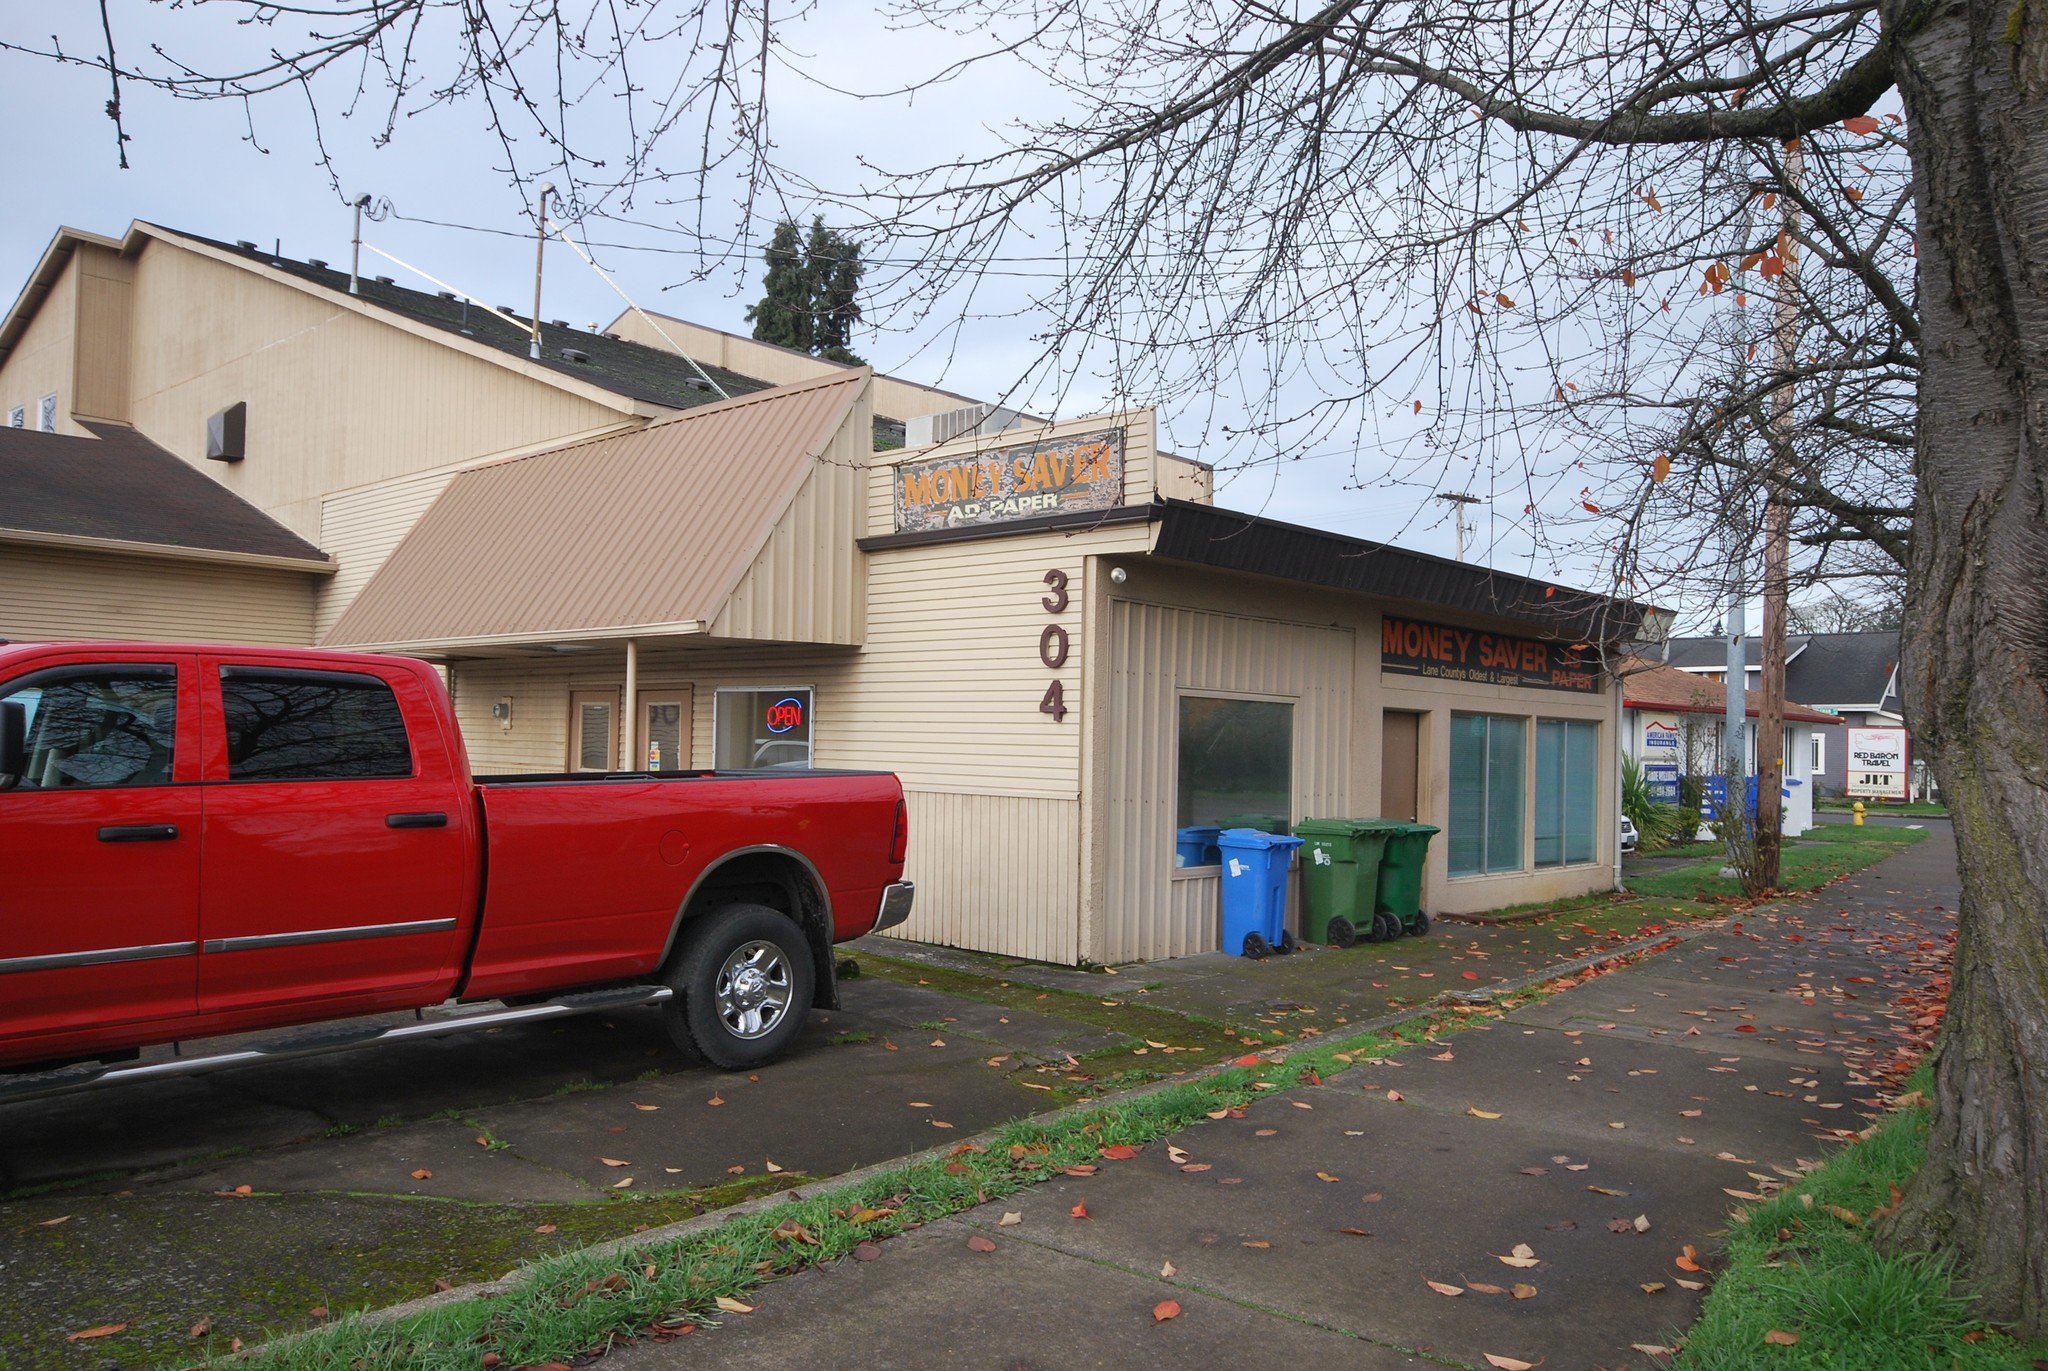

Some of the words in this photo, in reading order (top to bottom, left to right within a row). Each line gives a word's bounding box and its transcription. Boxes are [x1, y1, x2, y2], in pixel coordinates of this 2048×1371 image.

[903, 462, 1003, 507] MONEY
[1012, 442, 1111, 493] SAVER
[990, 491, 1058, 517] PAPER
[1039, 568, 1069, 723] 304
[1382, 619, 1473, 664] MONEY
[1479, 634, 1548, 673] SAVER
[1422, 663, 1439, 676] Lane
[1468, 668, 1488, 682] Oldest
[1490, 671, 1495, 682] &
[1497, 673, 1519, 686] Largest
[1552, 669, 1592, 689] PAPER
[767, 706, 801, 727] OPEN
[1861, 759, 1891, 767] TRAVEL
[1869, 752, 1899, 760] BARON
